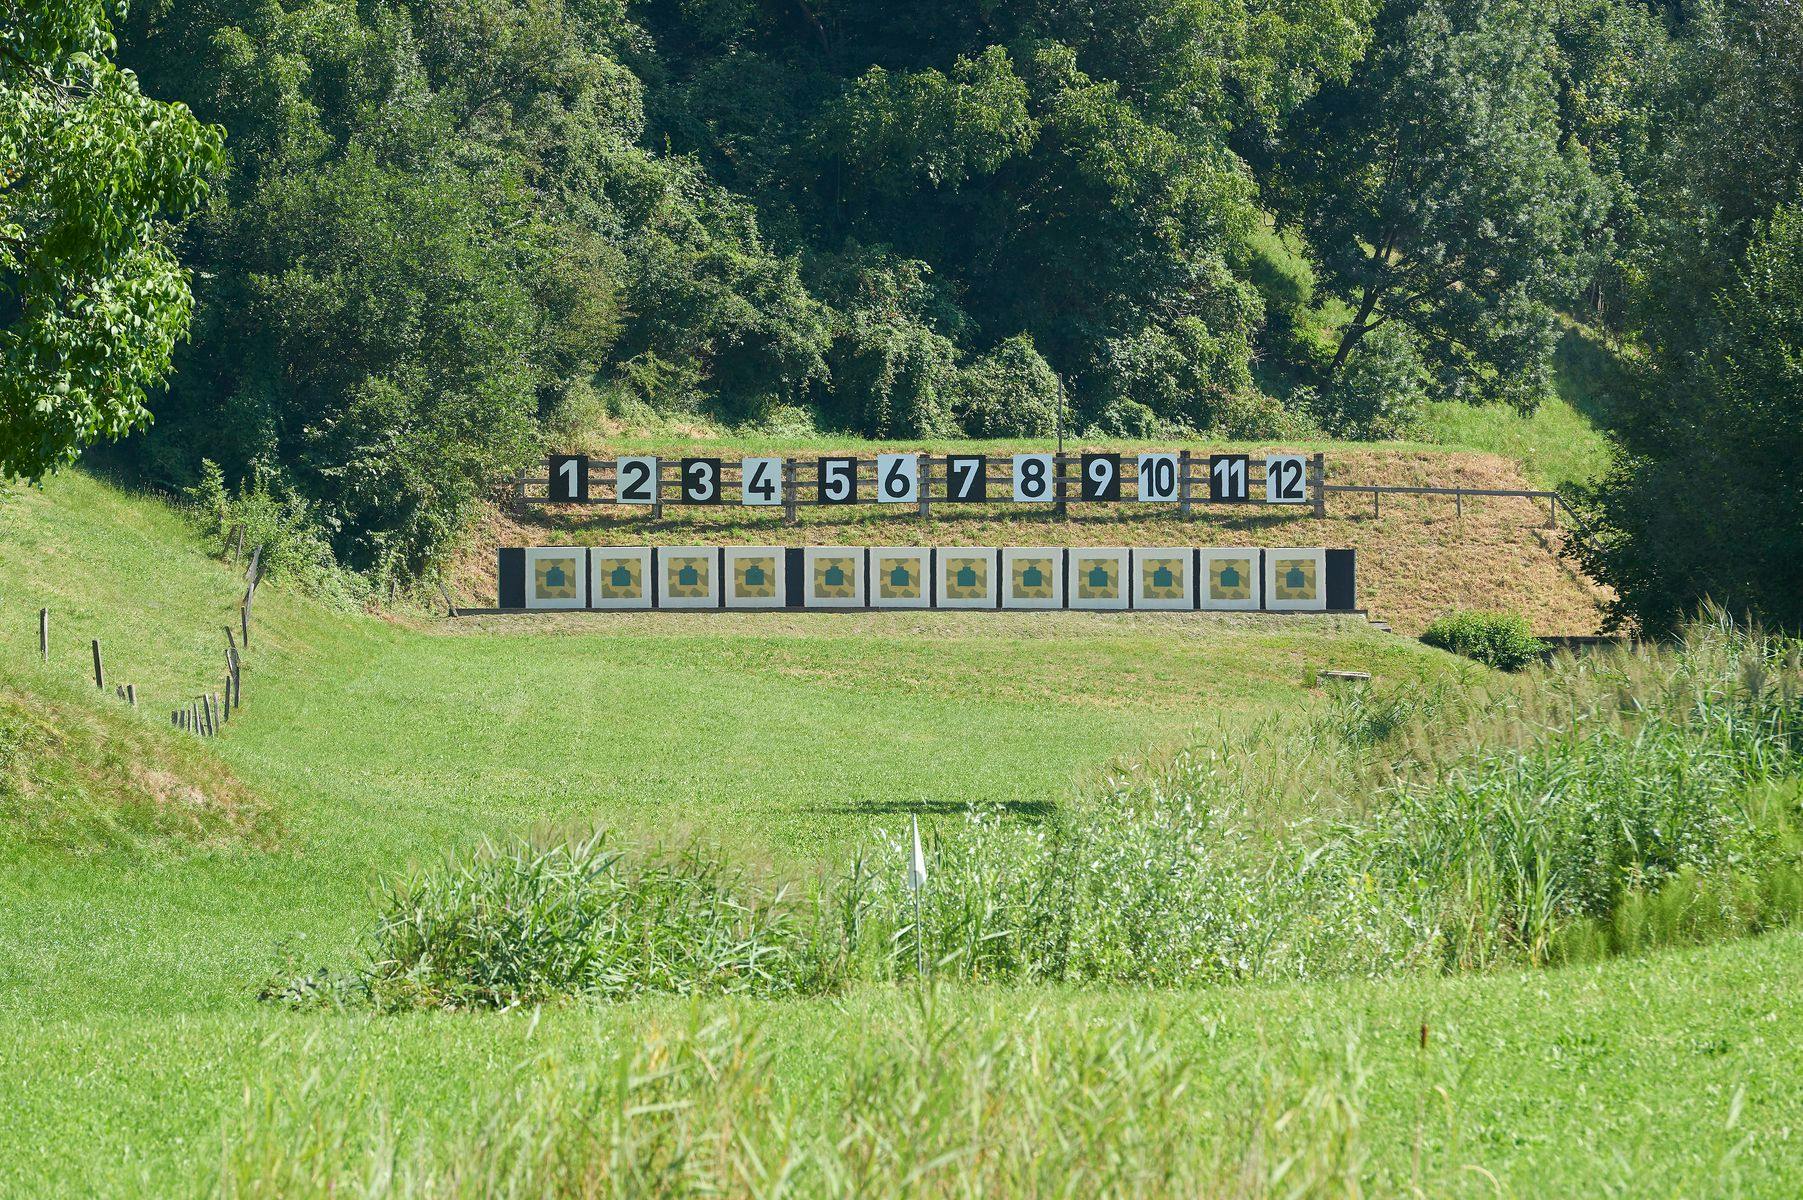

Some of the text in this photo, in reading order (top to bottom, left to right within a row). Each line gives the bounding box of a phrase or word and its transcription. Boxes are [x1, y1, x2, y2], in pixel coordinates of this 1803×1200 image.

[559, 460, 578, 498] 1
[622, 461, 651, 500] 2
[688, 462, 714, 500] 3
[748, 462, 775, 501] 4
[825, 461, 850, 500] 5
[885, 459, 910, 498] 6
[953, 460, 980, 498] 7
[1021, 459, 1046, 497] 8
[1088, 459, 1113, 496] 9
[1141, 458, 1175, 497] 10
[1214, 460, 1246, 498] 11
[1269, 459, 1303, 499] 12
